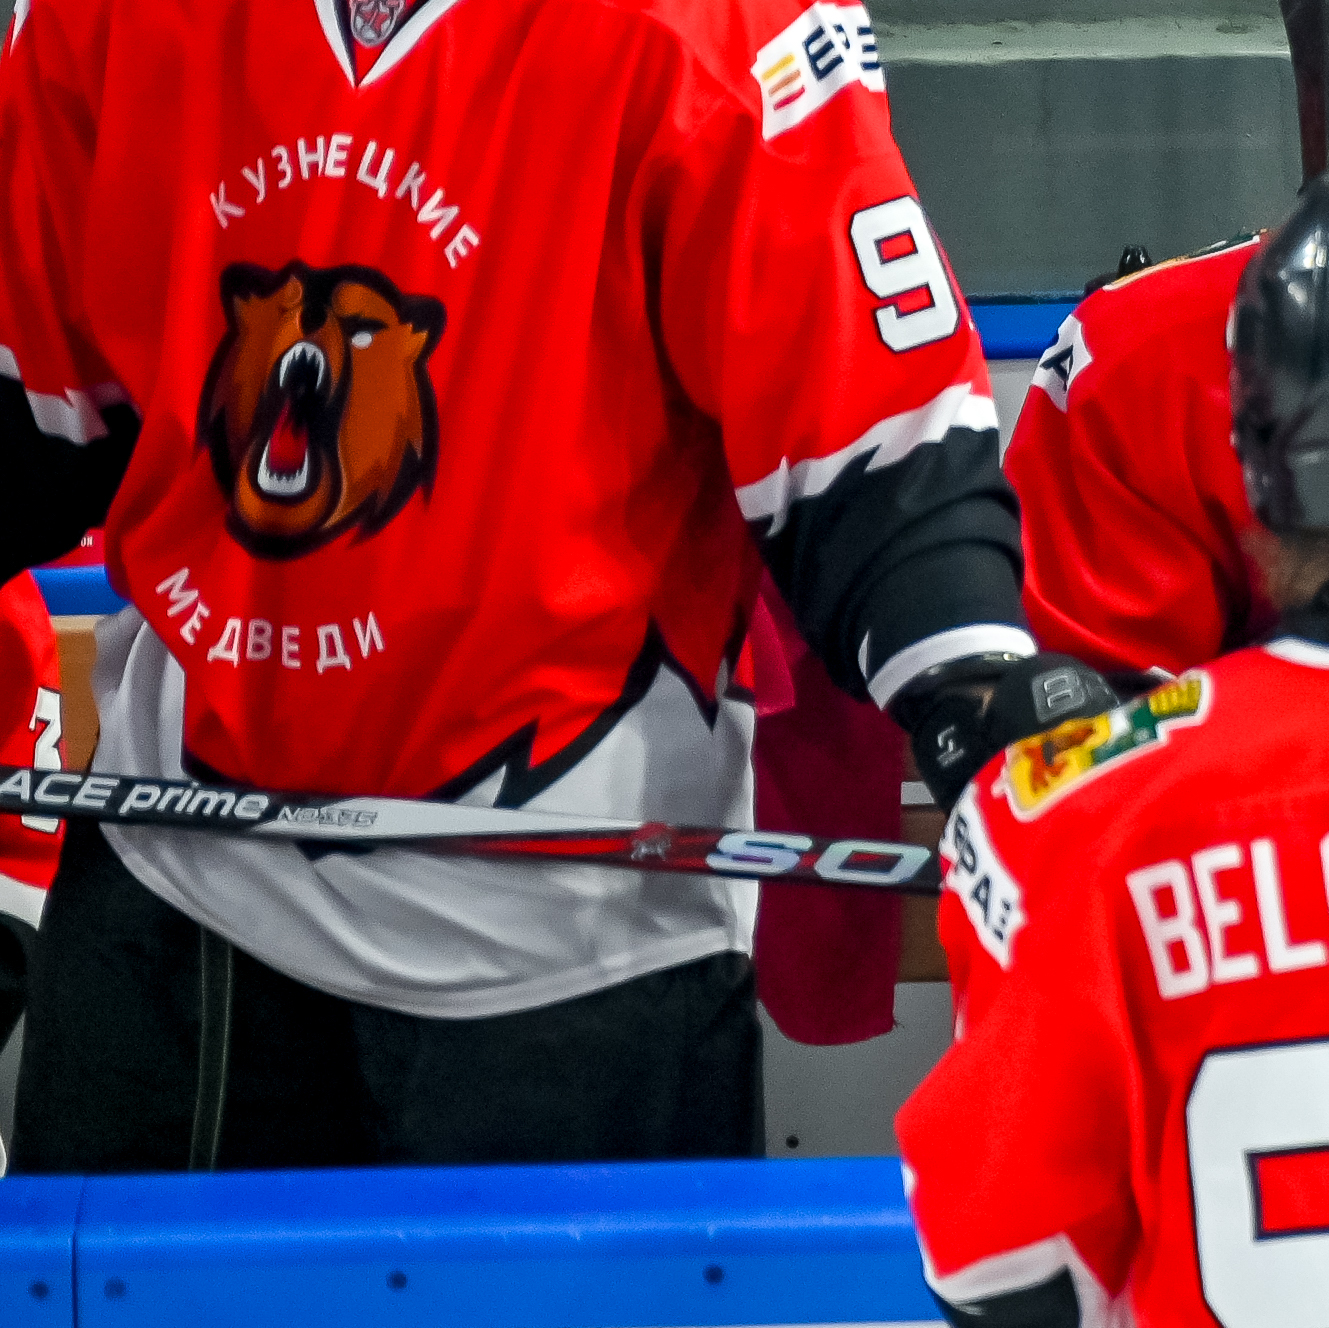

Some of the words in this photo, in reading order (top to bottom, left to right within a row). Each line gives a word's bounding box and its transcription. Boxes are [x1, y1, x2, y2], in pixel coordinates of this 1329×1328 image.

[209, 132, 481, 270] КУЗНЕЦКИЕ
[155, 566, 385, 675] МЕДВЕДИ
[0, 769, 119, 808] ACE
[119, 781, 271, 821] prime
